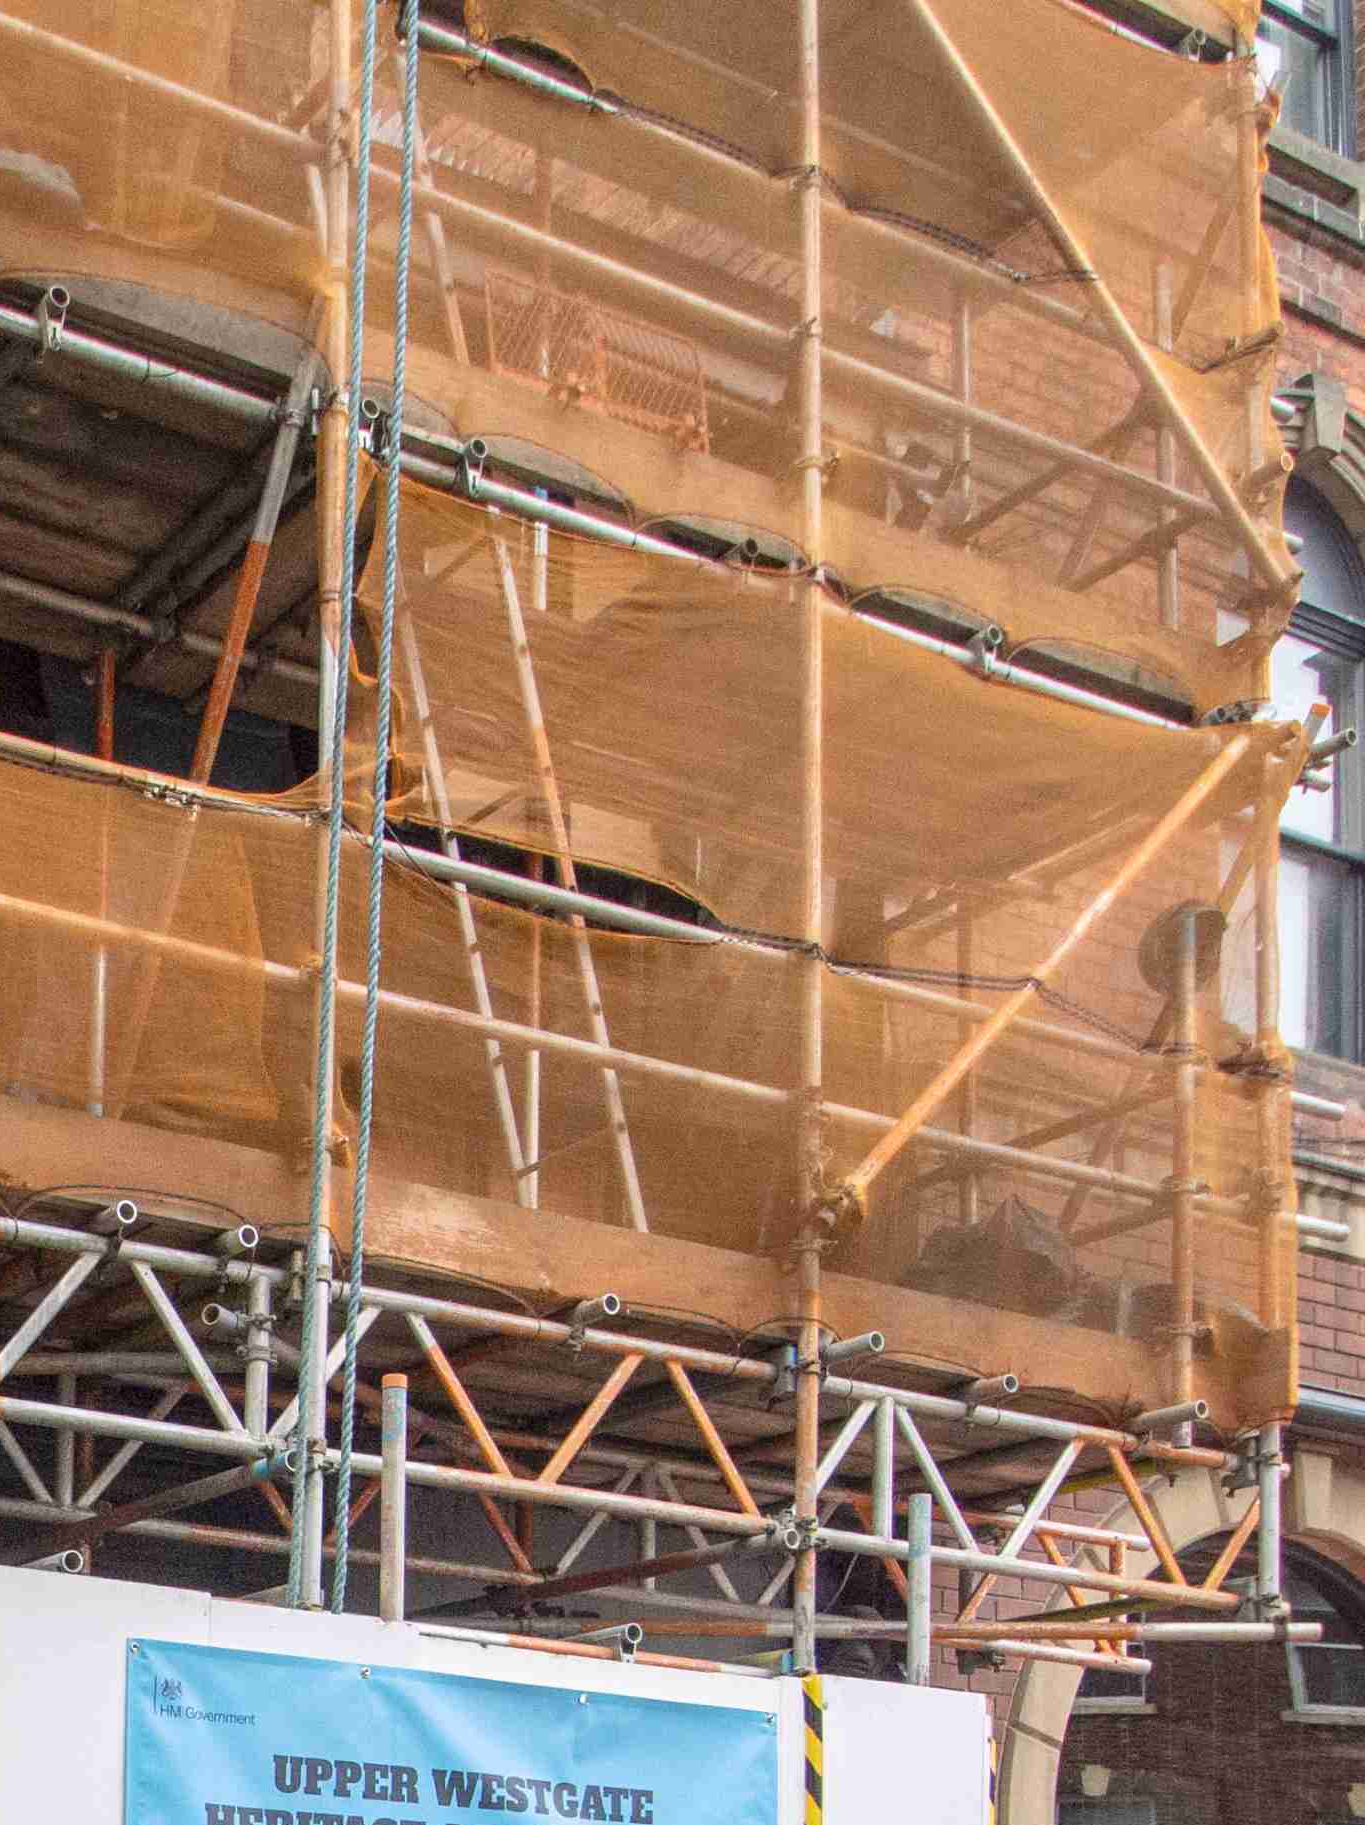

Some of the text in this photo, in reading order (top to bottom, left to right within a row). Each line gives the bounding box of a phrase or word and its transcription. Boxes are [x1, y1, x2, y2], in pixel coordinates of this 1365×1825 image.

[160, 1703, 256, 1726] HM Government
[272, 1754, 654, 1825] UPPER WESTGATE
